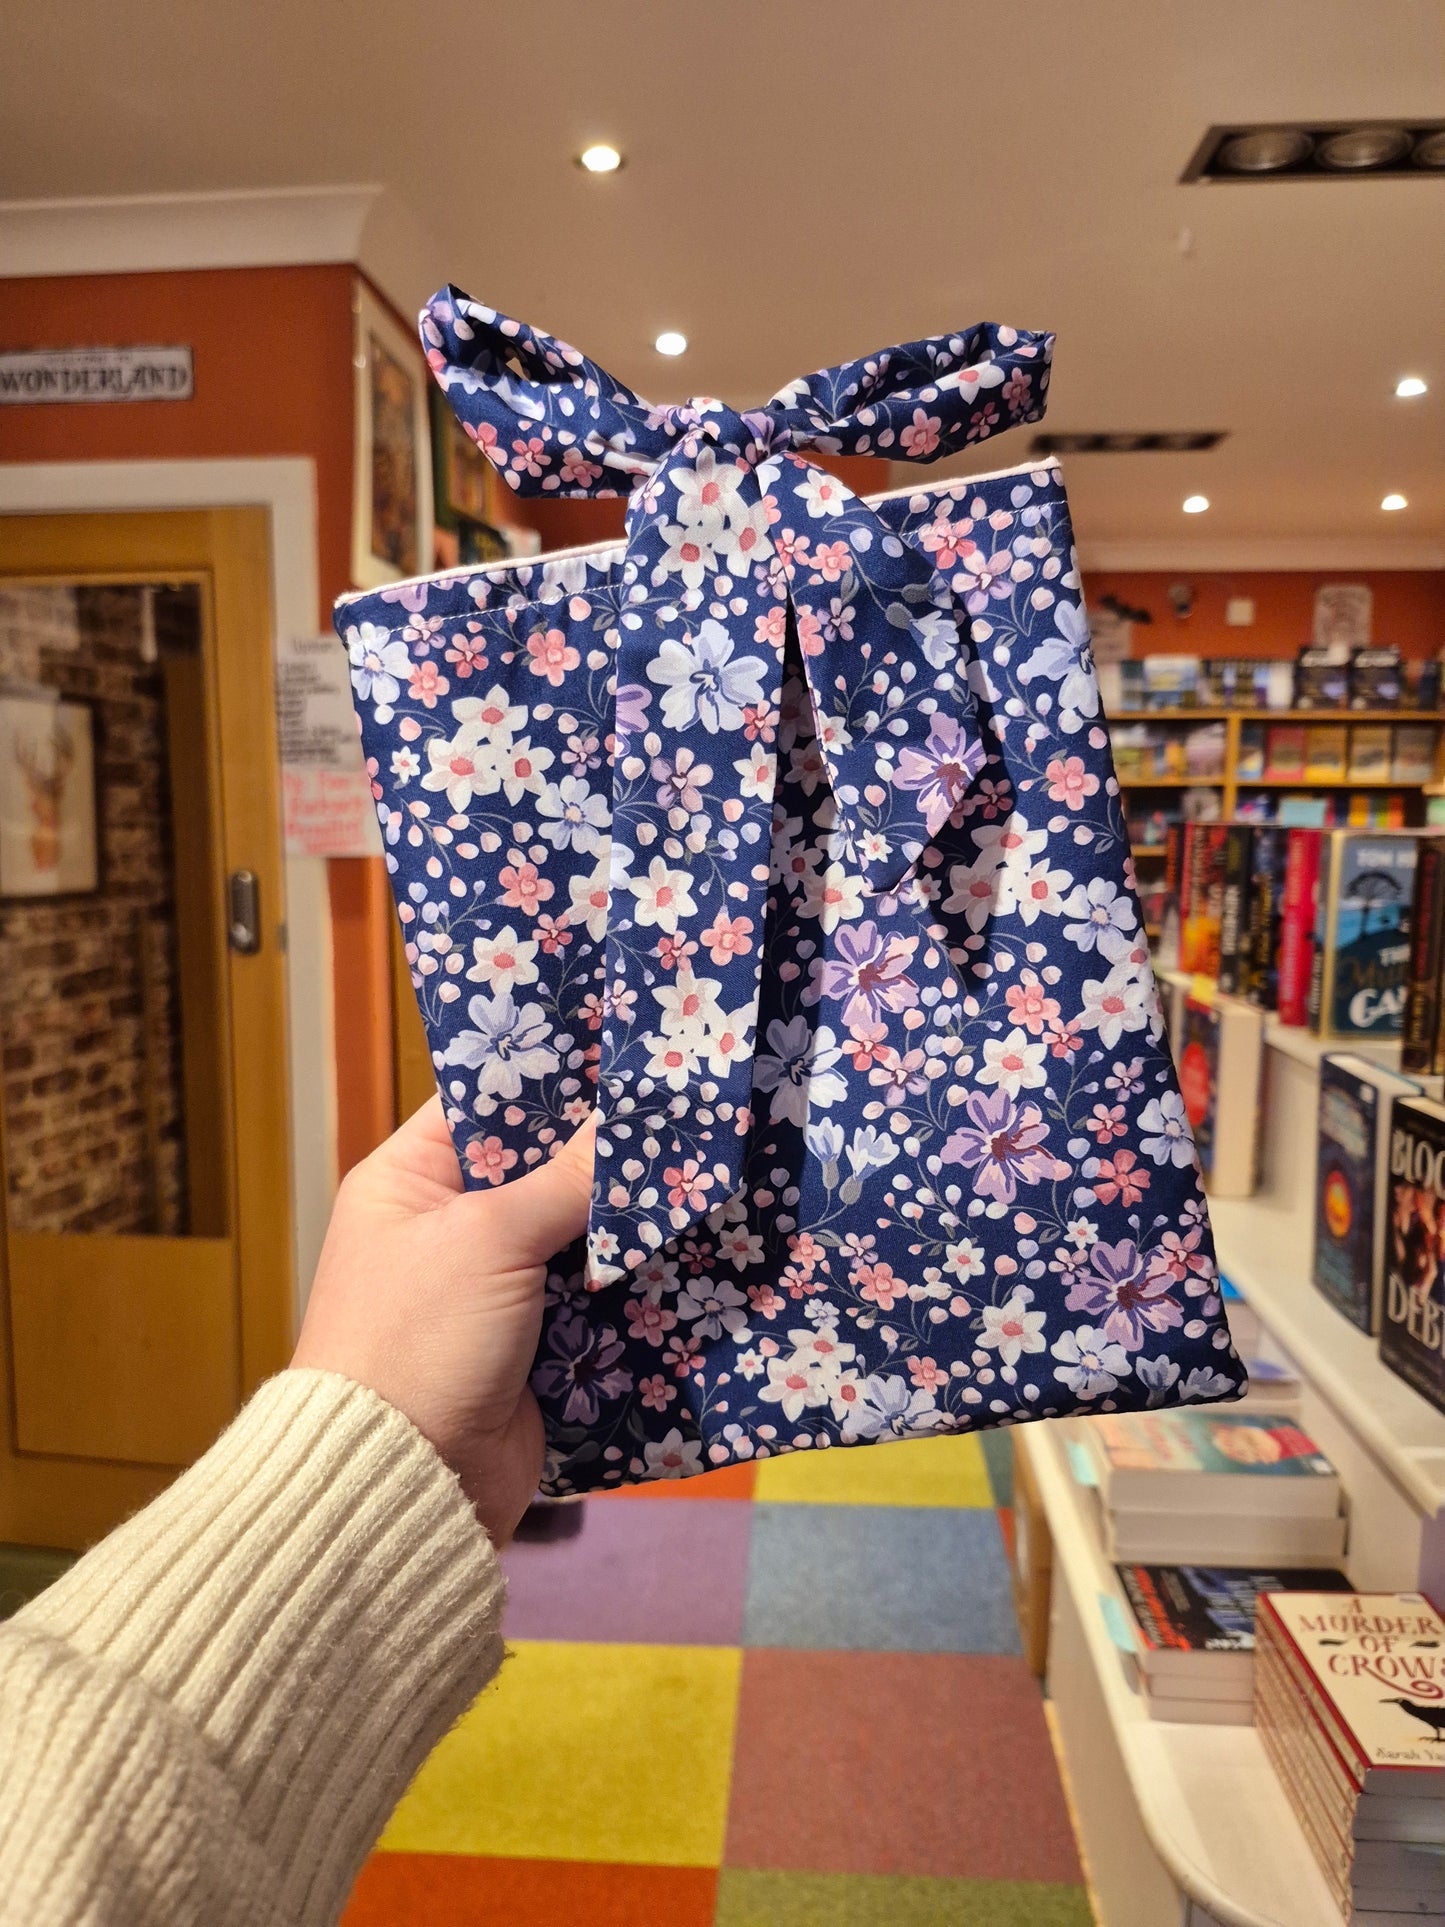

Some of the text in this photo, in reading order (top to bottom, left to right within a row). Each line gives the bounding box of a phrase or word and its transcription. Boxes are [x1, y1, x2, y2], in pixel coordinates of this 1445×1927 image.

[0, 364, 188, 395] WONDERLAND
[1349, 1597, 1363, 1614] A
[1298, 1613, 1443, 1636] MURDER
[1359, 1633, 1399, 1653] OF
